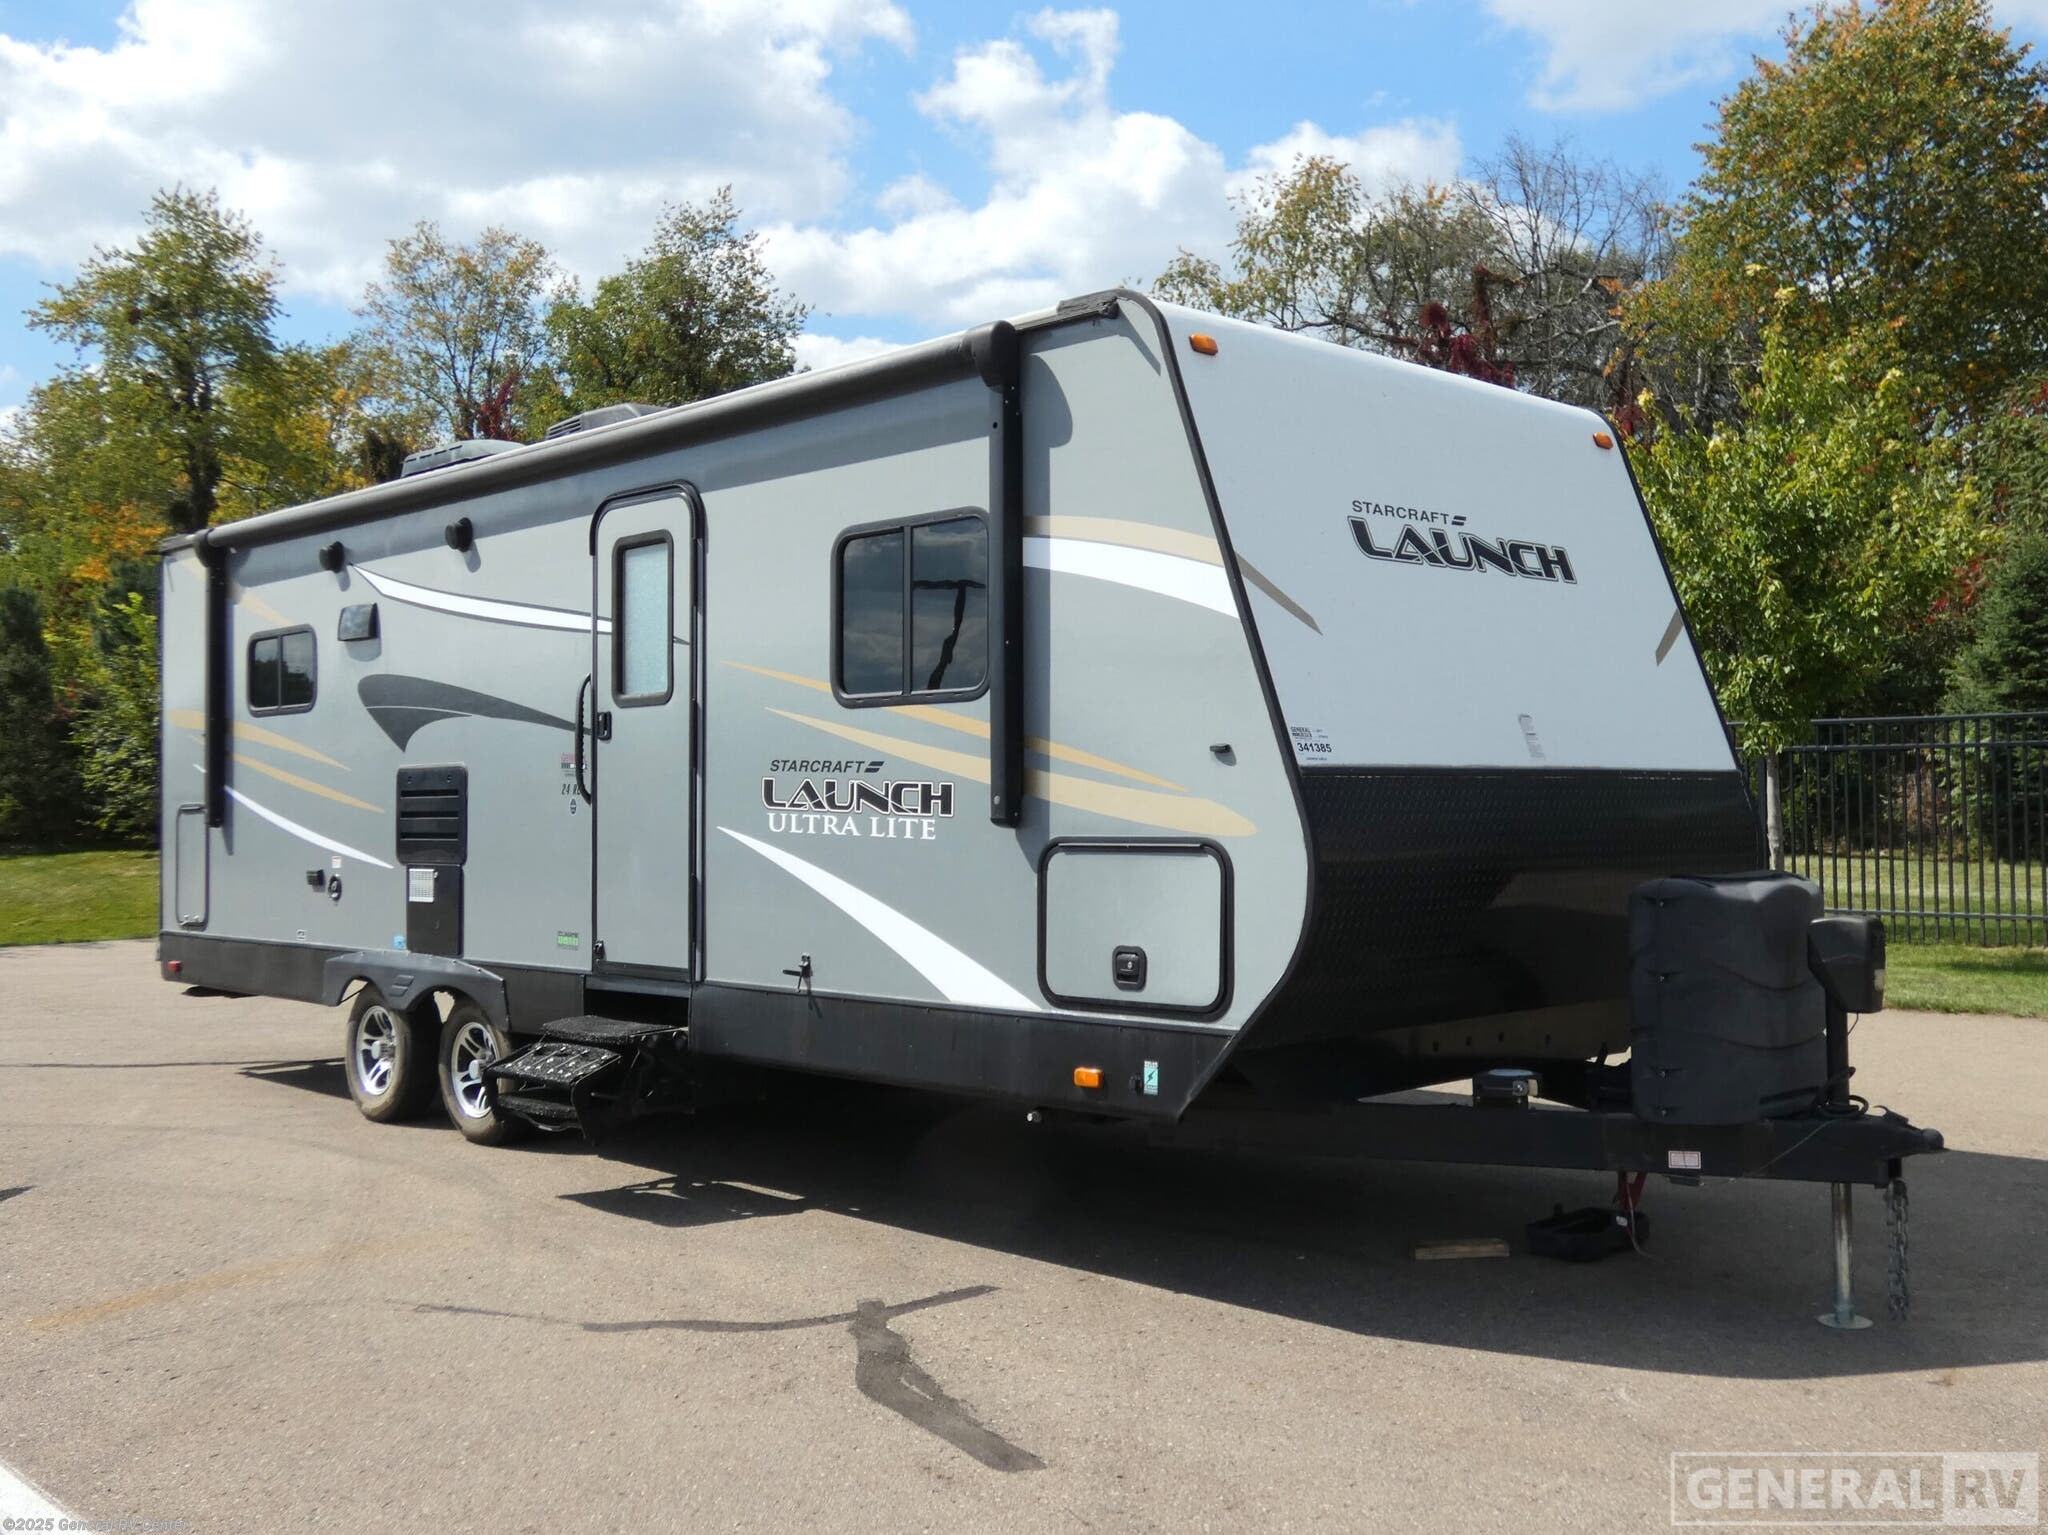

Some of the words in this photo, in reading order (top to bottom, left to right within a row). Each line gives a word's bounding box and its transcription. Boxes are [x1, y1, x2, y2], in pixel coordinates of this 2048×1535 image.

[1351, 500, 1449, 525] STARCRAFT
[1347, 515, 1578, 585] LAUNCH
[1296, 742, 1332, 753] 341385
[769, 759, 865, 774] STARCRAFT
[561, 783, 571, 796] 24
[761, 777, 954, 818] LAUNCH
[767, 813, 861, 836] ULTRA
[869, 816, 936, 840] LITE
